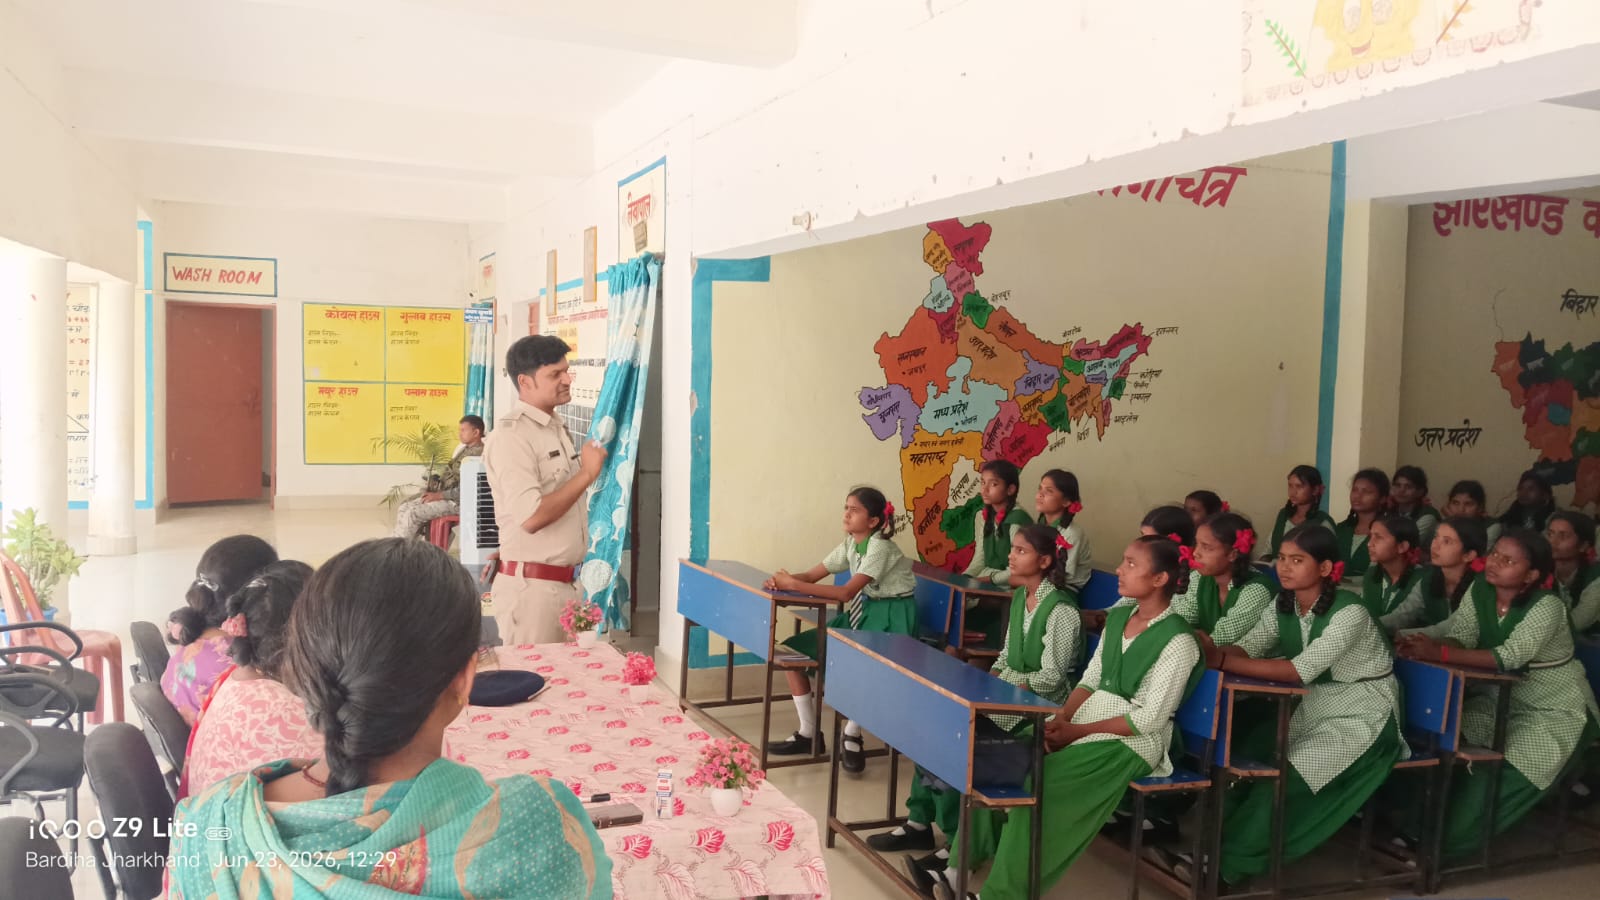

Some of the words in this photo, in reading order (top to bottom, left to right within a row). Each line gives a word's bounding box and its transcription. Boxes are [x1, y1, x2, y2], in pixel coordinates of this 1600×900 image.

[172, 265, 213, 284] WASH
[218, 268, 263, 286] ROOM
[1560, 288, 1600, 321] बिहार
[933, 406, 950, 421] मध्य
[950, 400, 969, 417] प्रदेश
[1414, 427, 1445, 453] उत्तर
[1444, 417, 1483, 455] प्रदेश
[910, 450, 948, 467] महाराष्ट्र
